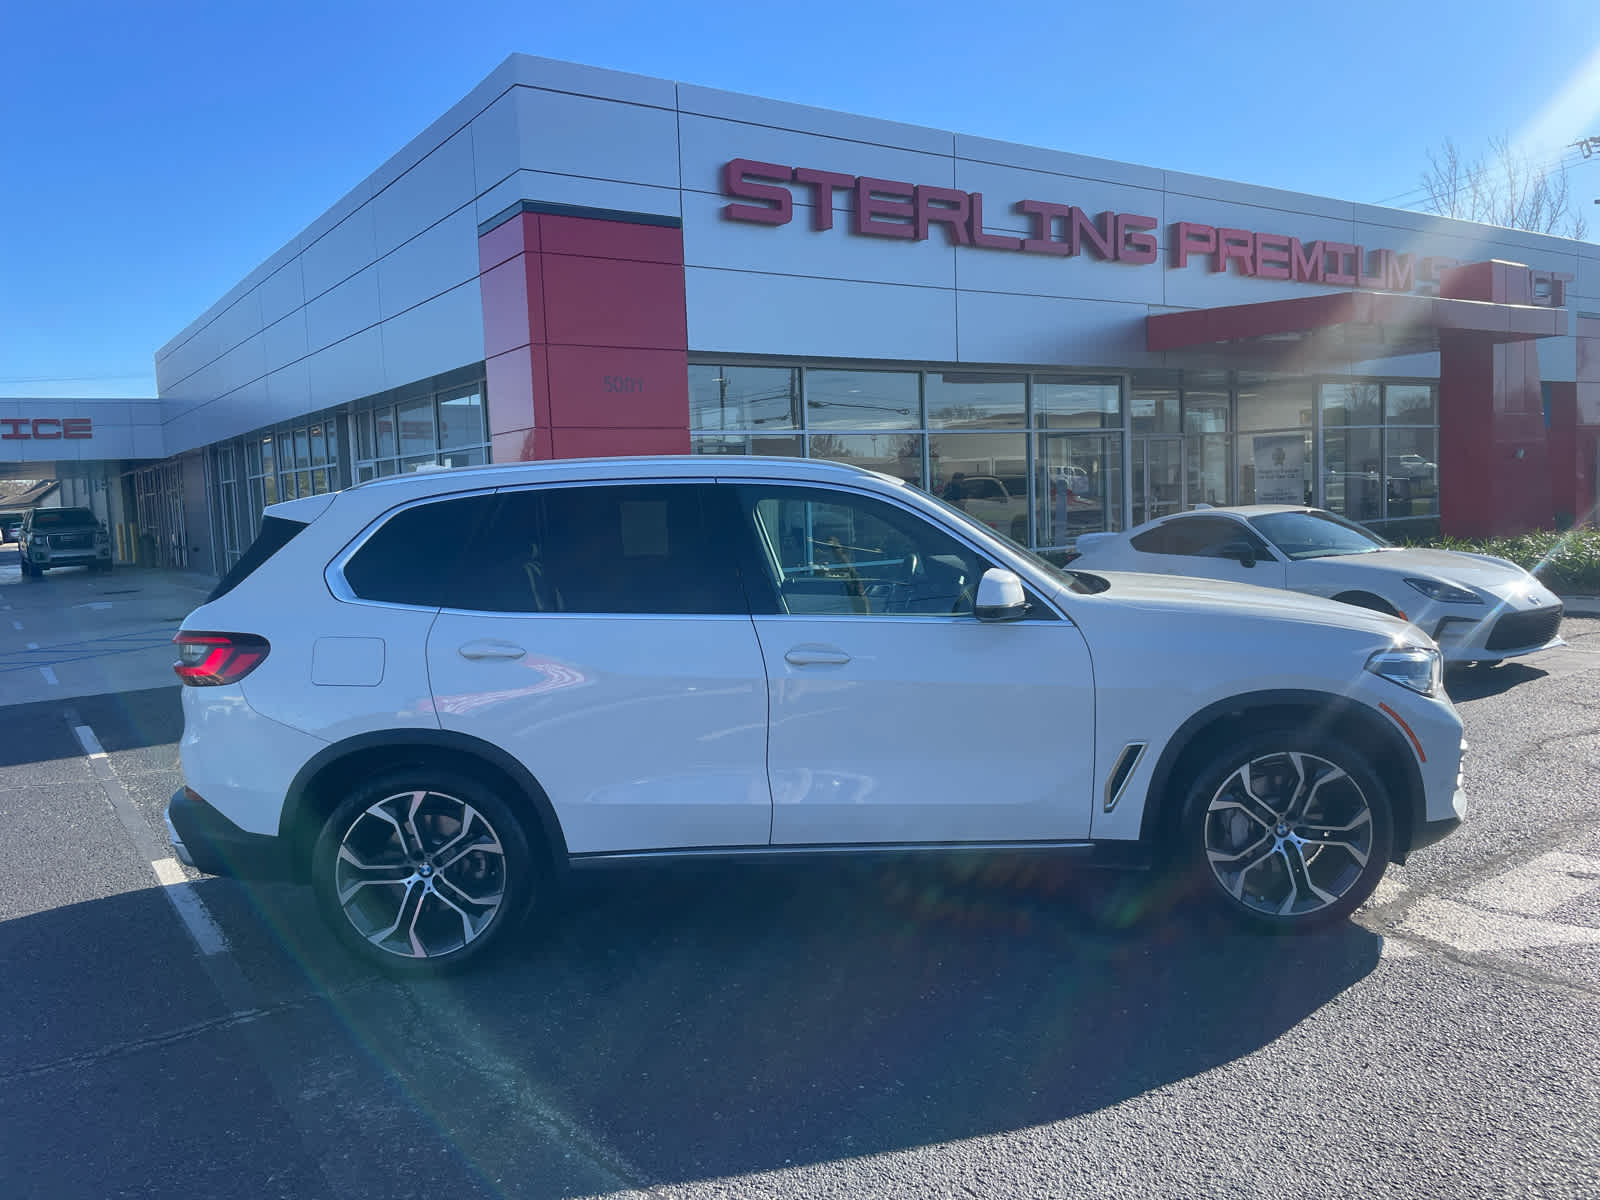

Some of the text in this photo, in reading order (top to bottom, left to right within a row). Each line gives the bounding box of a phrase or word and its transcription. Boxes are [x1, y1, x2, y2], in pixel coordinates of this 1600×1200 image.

[722, 158, 1157, 265] STERLING
[1169, 221, 1416, 291] PREMIUM
[602, 375, 643, 394] 5001
[0, 418, 92, 440] ICE
